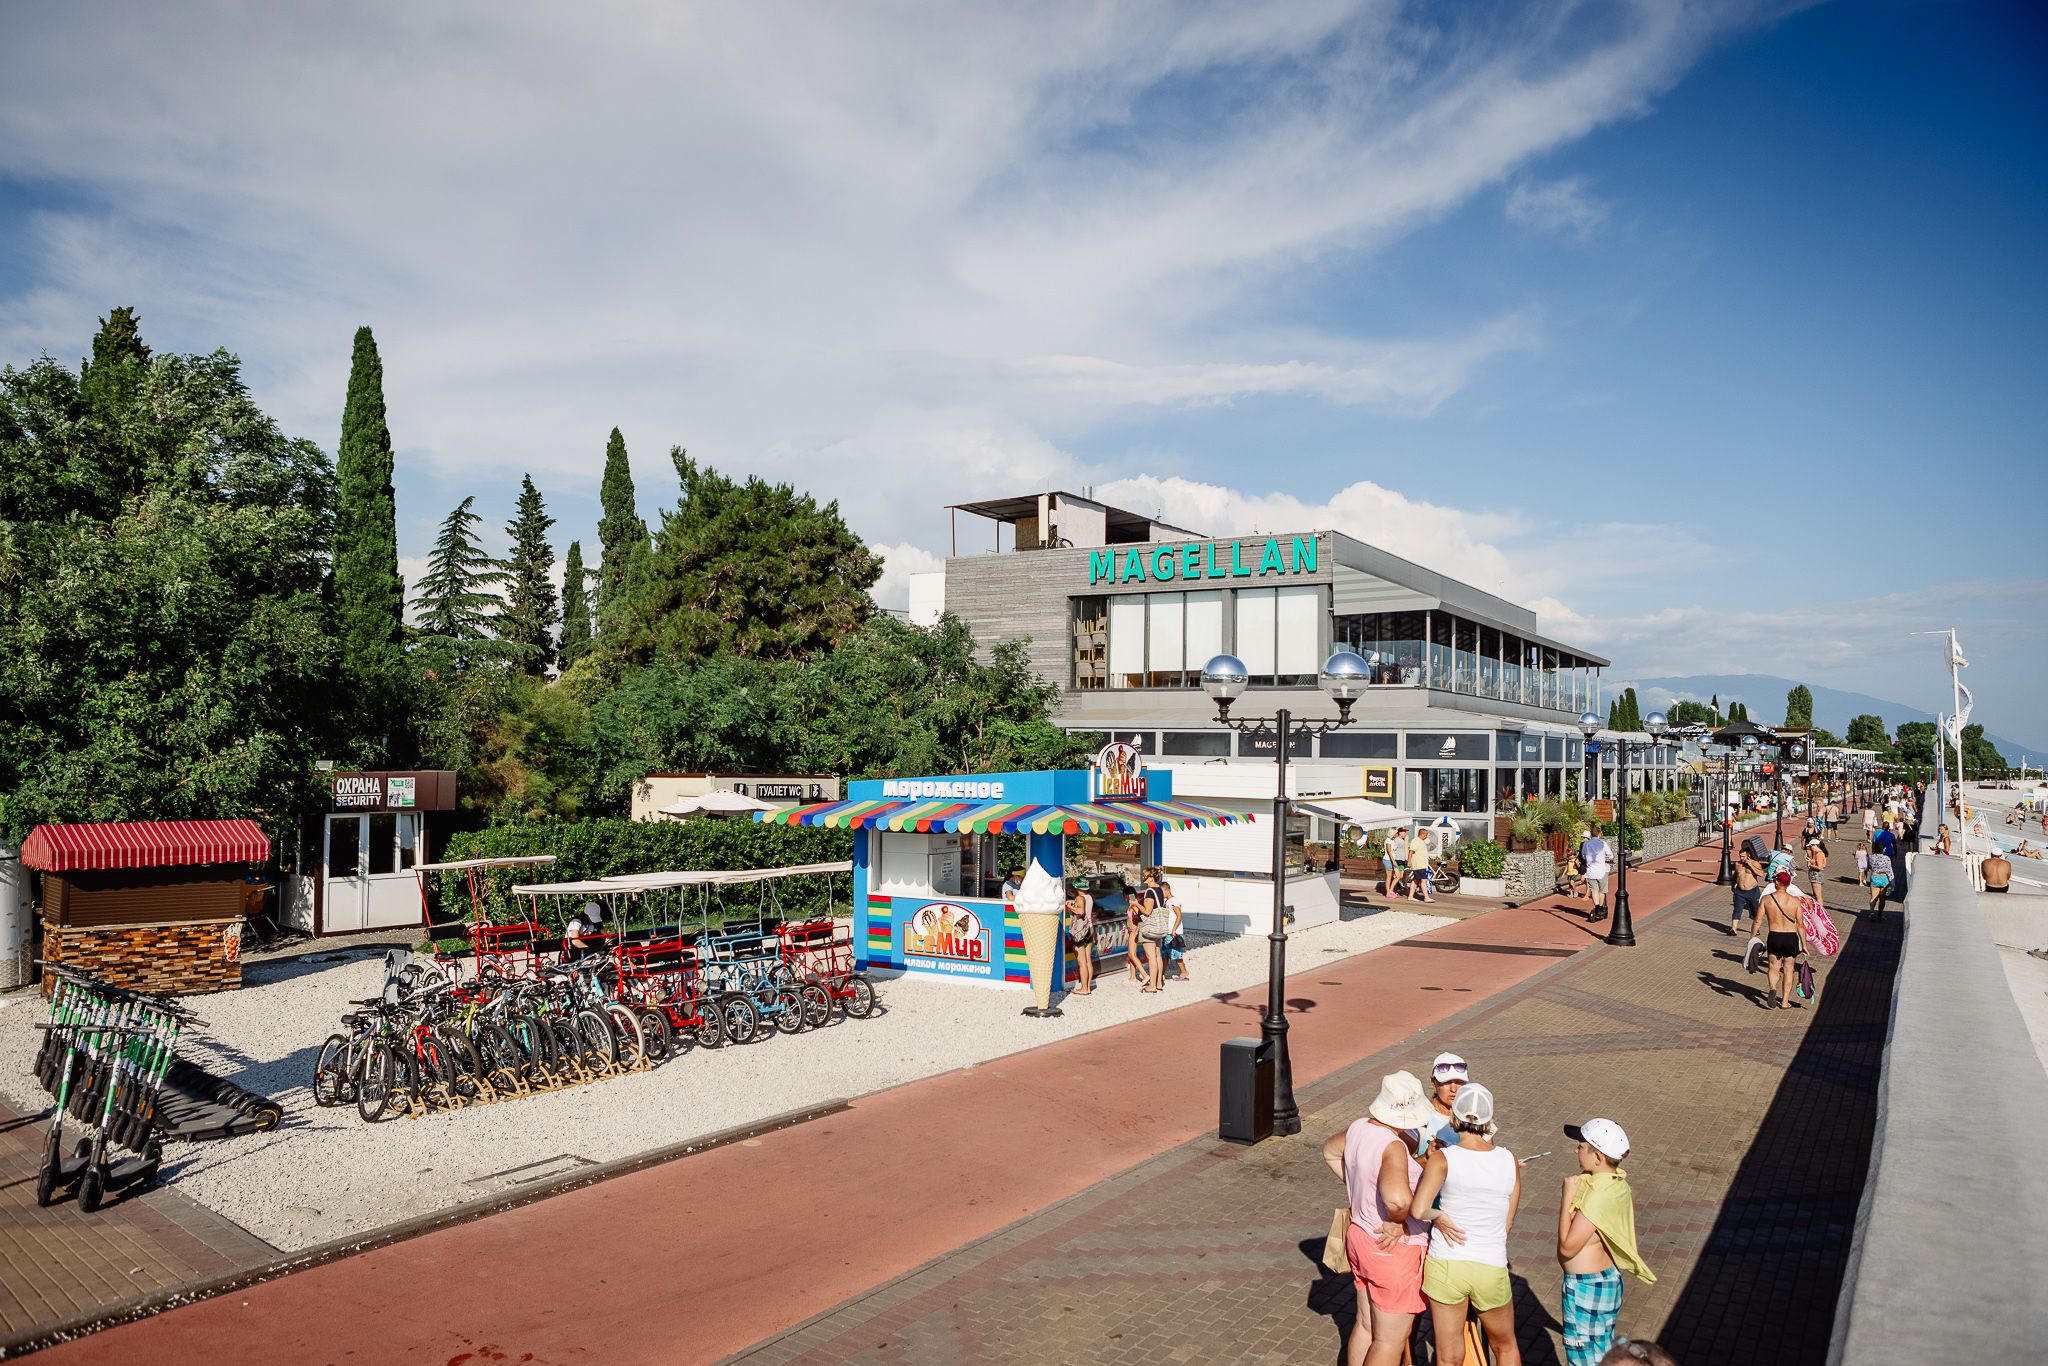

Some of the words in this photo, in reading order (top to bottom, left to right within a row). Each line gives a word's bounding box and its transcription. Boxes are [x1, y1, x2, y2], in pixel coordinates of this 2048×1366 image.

[1089, 536, 1318, 585] MAGELLAN
[336, 777, 381, 794] ОХРАНА
[759, 785, 788, 797] ТУАЛЕТ
[788, 785, 802, 796] WC
[335, 795, 382, 807] SECURITY
